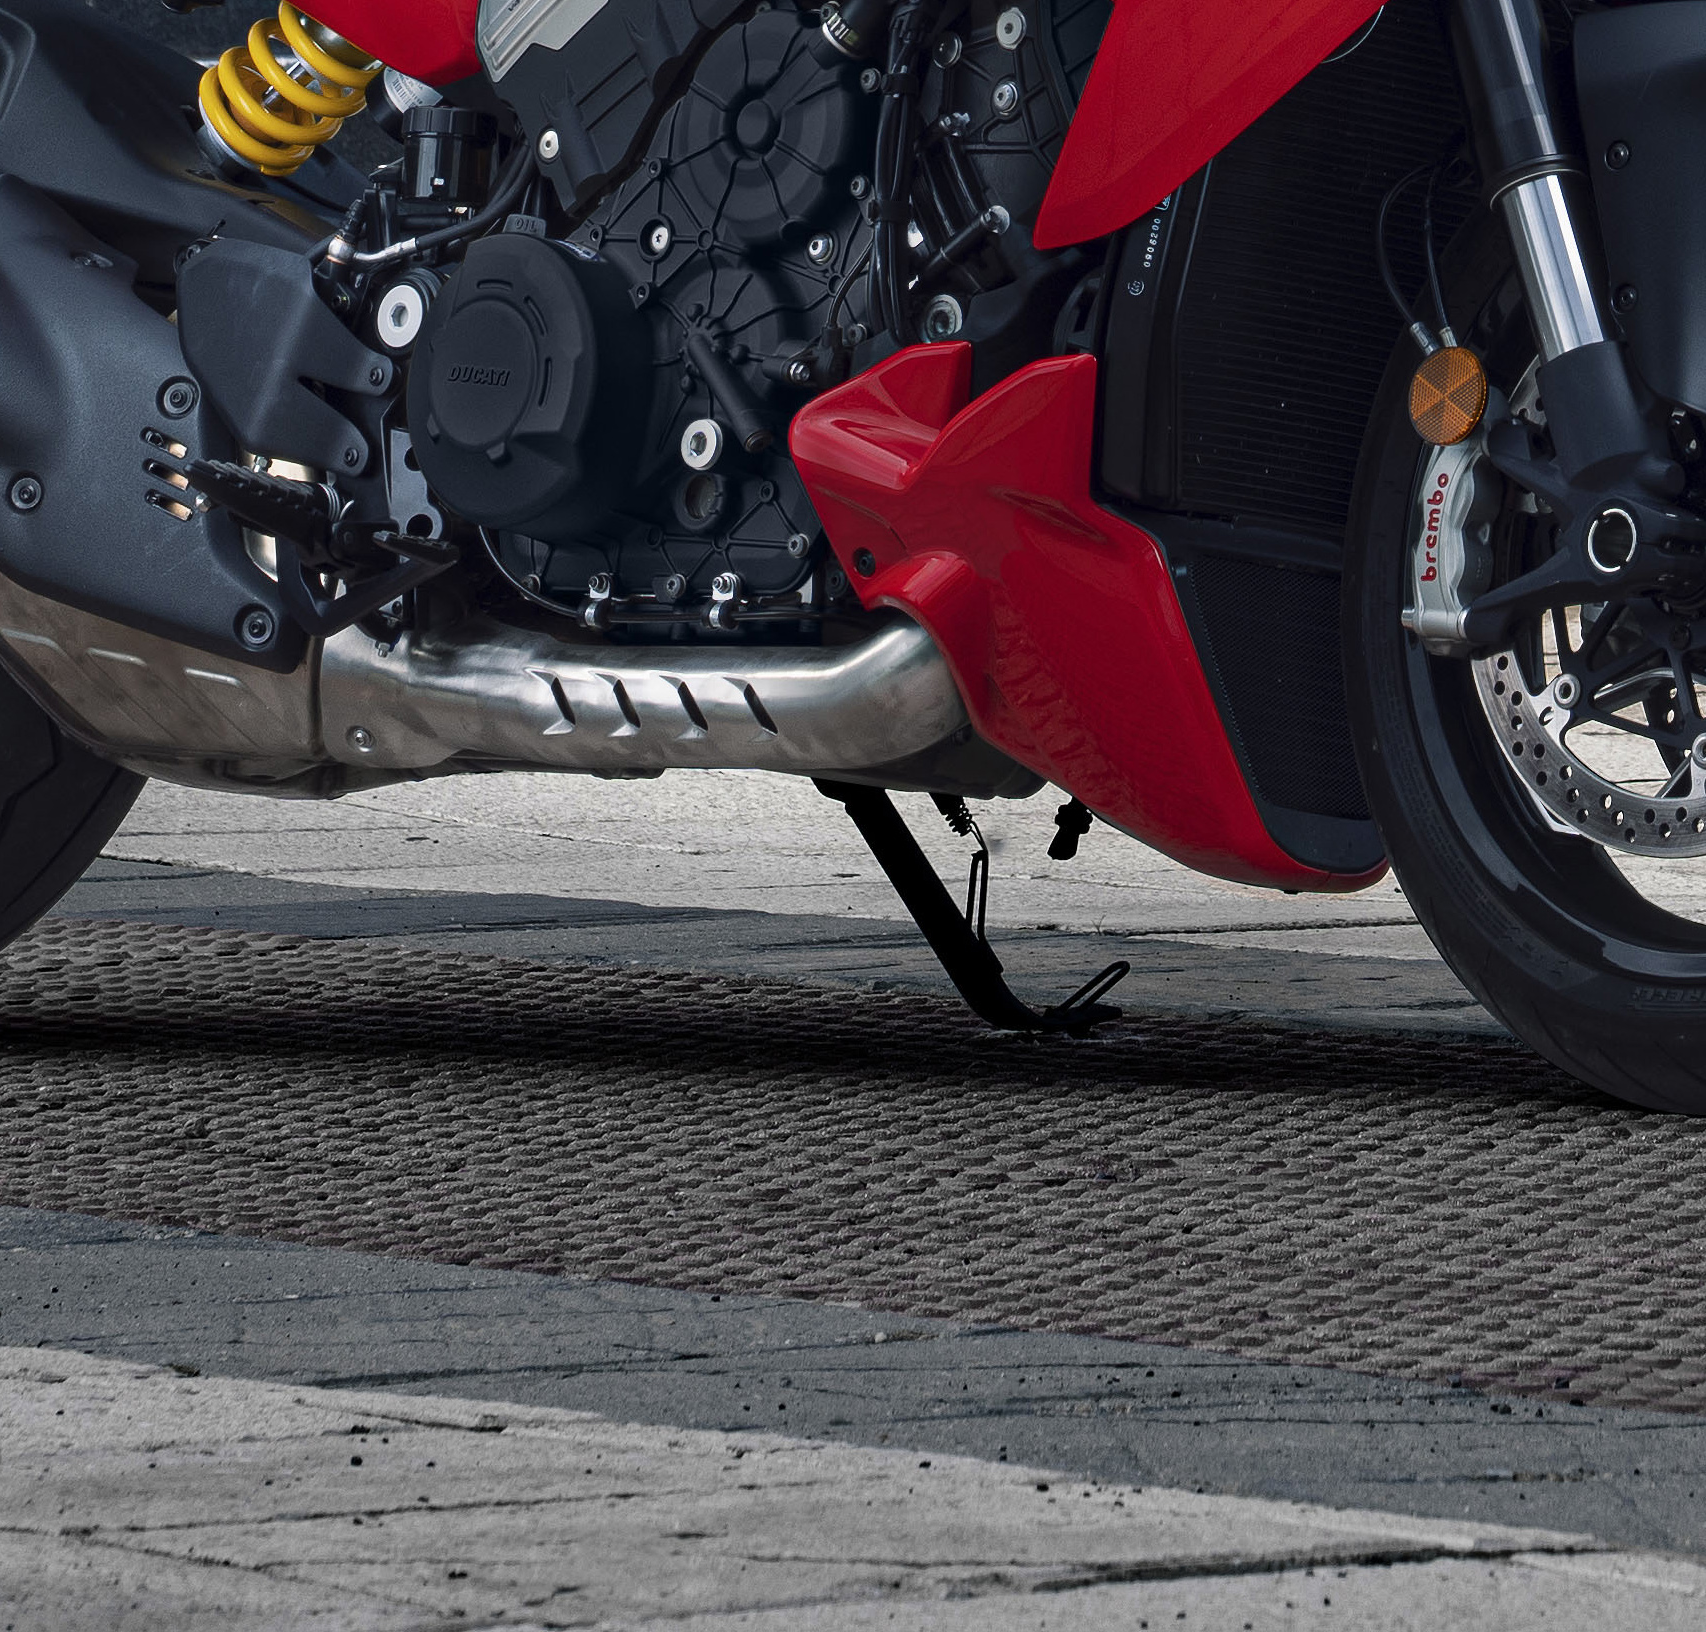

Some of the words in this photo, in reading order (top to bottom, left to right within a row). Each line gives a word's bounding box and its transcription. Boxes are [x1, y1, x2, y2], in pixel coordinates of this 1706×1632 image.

[515, 217, 538, 233] OIL
[447, 364, 511, 387] DUCATI
[1420, 473, 1449, 582] brembo
